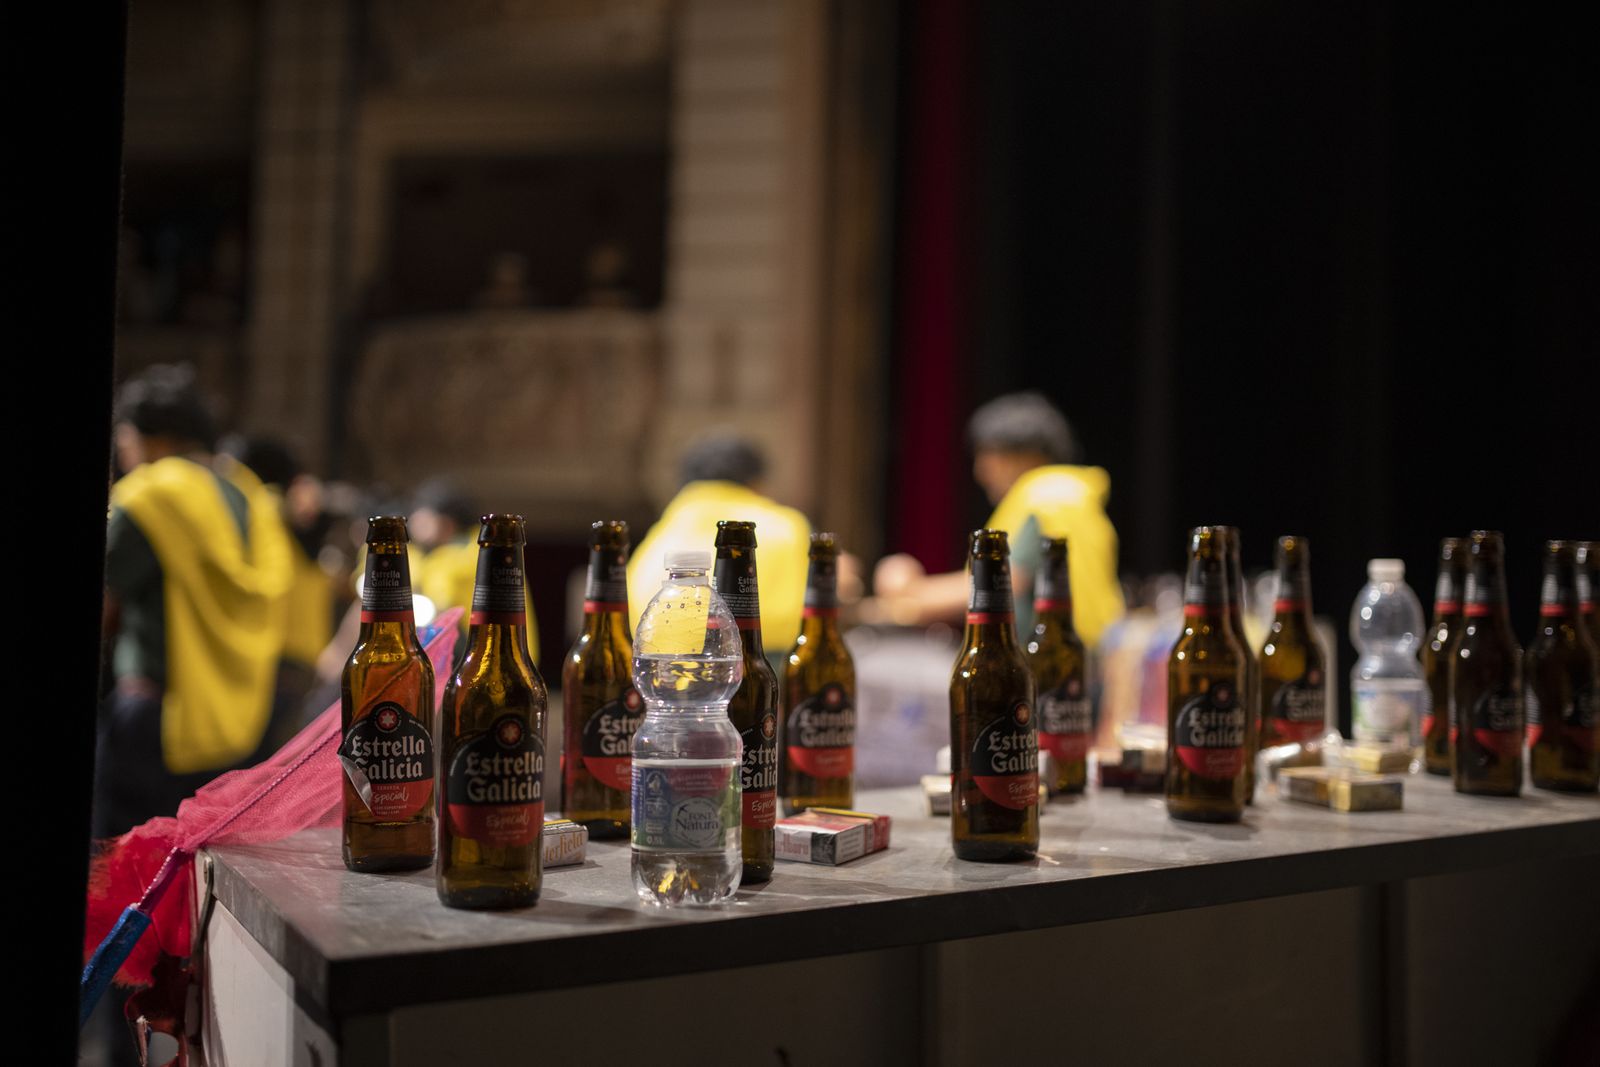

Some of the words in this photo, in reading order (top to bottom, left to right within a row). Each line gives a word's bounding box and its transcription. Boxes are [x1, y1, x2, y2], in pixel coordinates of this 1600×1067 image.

[351, 735, 425, 757] Estrella
[464, 751, 543, 776] Estrella
[467, 776, 541, 802] Galicia
